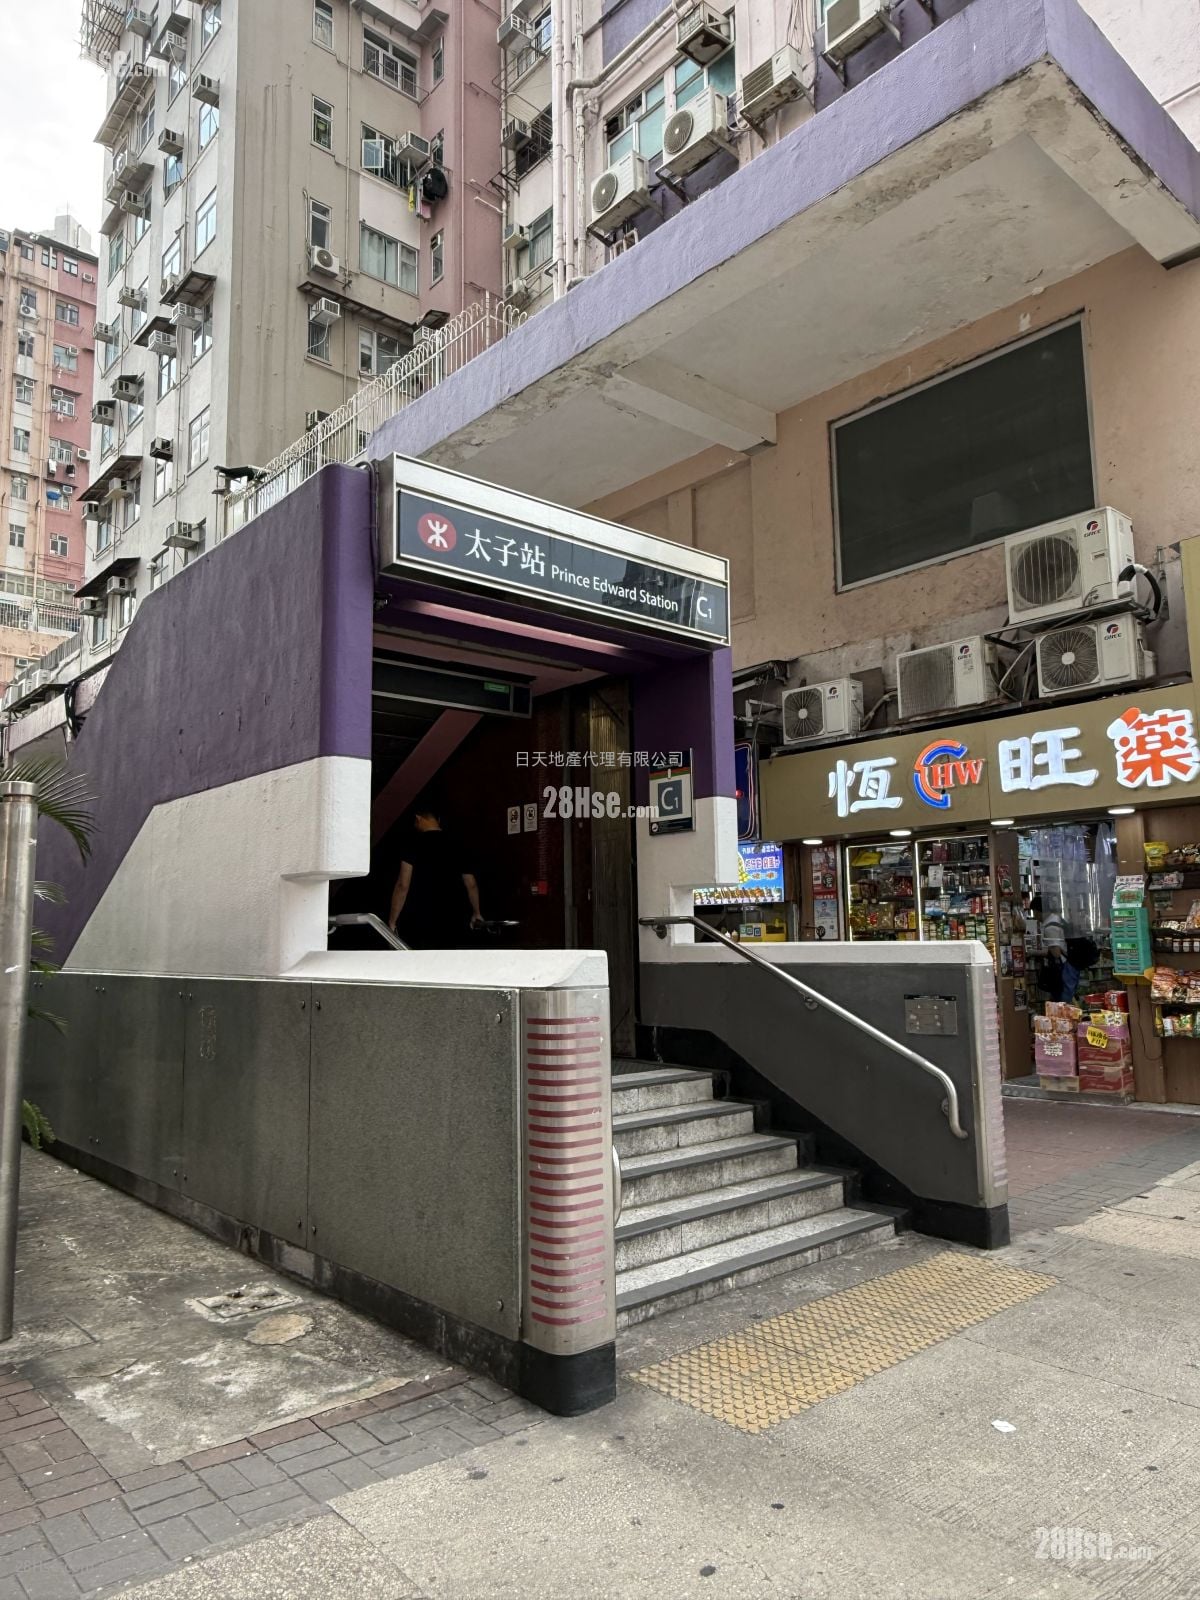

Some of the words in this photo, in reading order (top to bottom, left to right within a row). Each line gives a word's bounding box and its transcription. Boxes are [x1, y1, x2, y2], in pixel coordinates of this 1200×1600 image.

[464, 528, 546, 577] 太子站
[551, 564, 590, 588] Prince
[593, 576, 637, 601] Edward
[639, 589, 679, 612] Station
